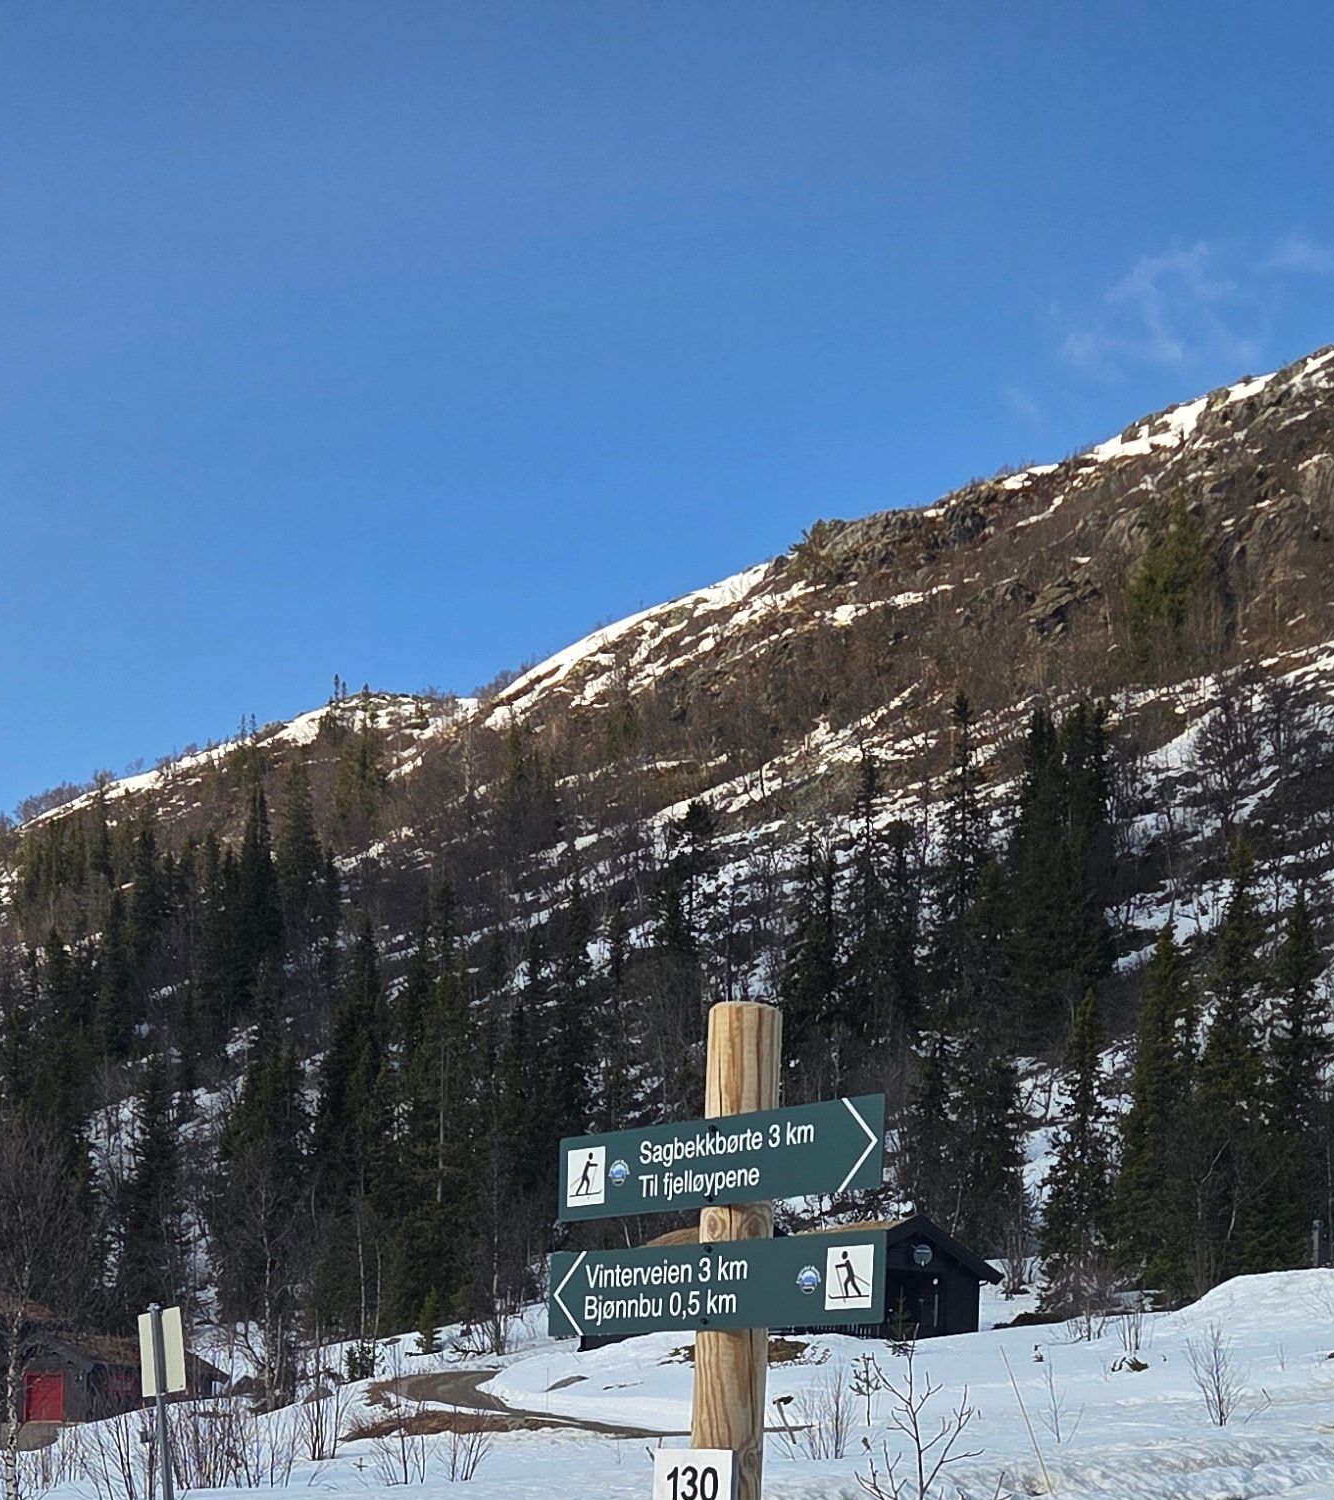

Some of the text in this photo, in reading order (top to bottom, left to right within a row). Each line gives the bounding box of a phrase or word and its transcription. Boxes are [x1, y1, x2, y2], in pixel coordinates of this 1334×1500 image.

[639, 1121, 814, 1167] Sagbekkbørte 3 km
[638, 1173, 658, 1198] Til
[663, 1167, 760, 1201] fjelløypene
[586, 1255, 748, 1289] Vinterveien 3 km
[584, 1289, 737, 1326] Bjønnbu 0,5 km
